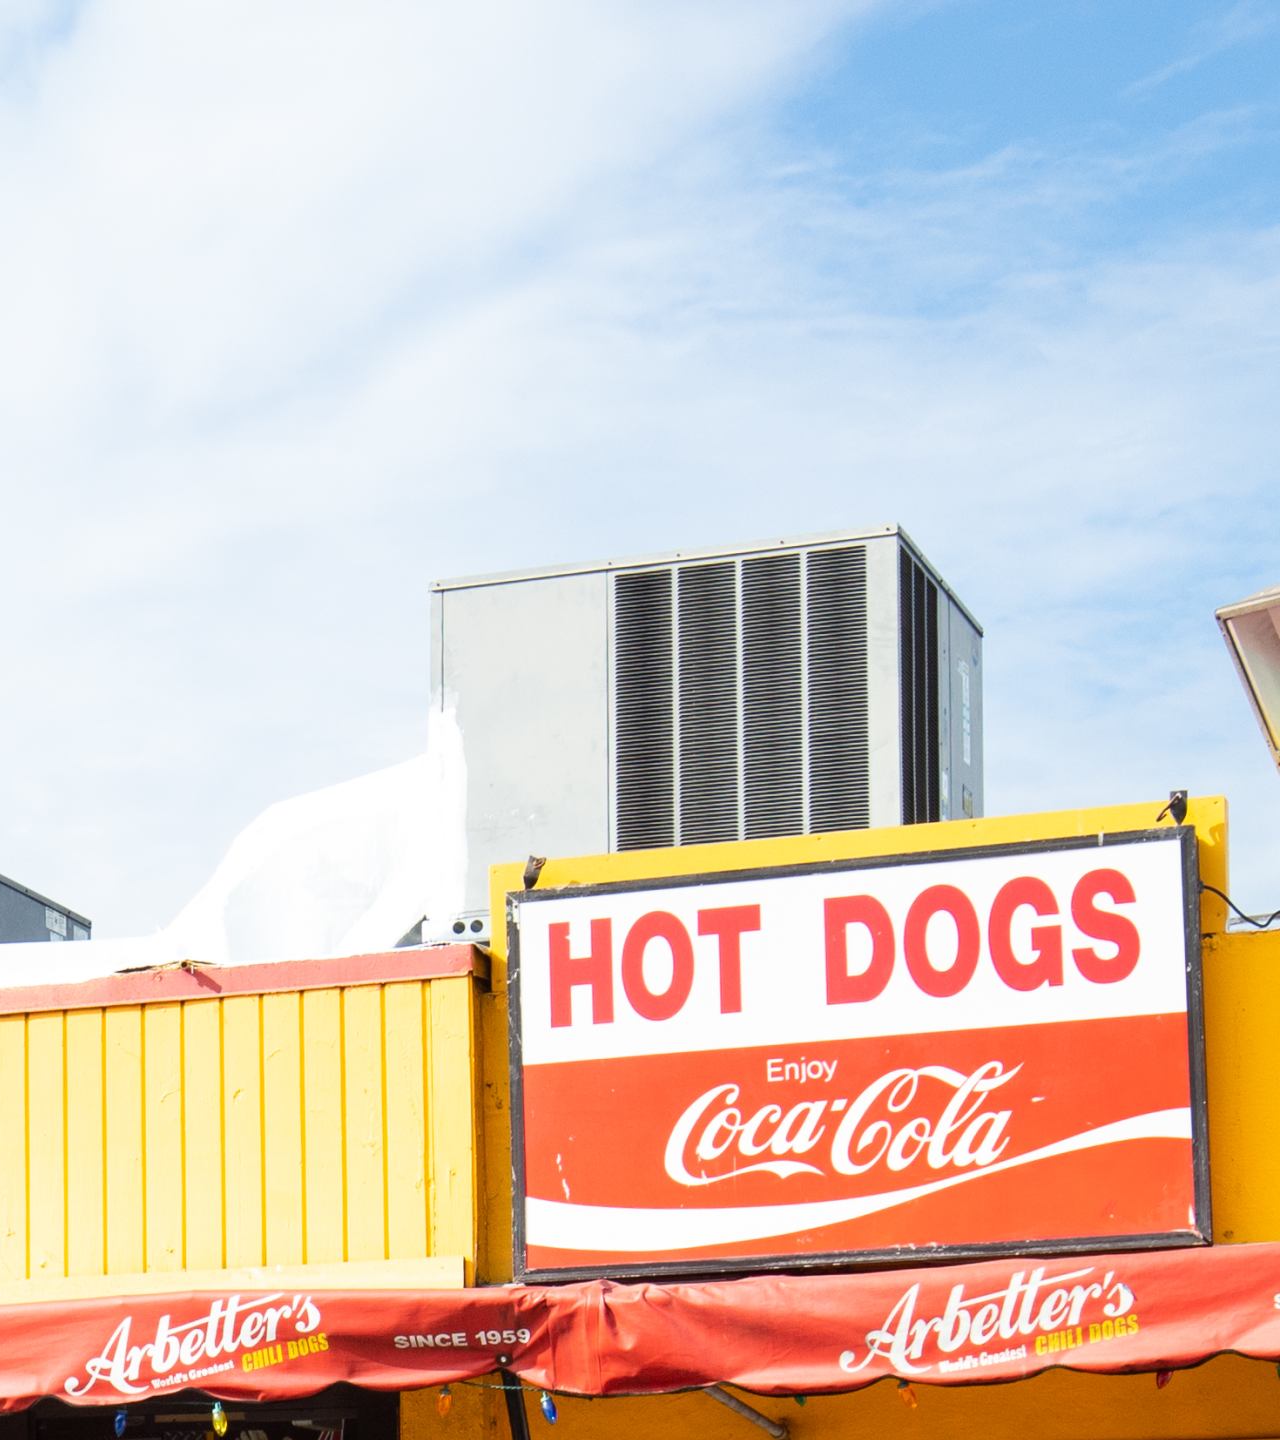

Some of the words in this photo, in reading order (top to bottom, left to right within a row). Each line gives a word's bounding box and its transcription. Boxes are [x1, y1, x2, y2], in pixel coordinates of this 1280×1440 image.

[547, 904, 762, 1029] HOT
[822, 867, 1141, 1007] DOGS
[765, 1055, 839, 1086] Enjoy
[664, 1060, 1026, 1188] Coca-Cola
[64, 1293, 321, 1396] Arbetter's
[394, 1332, 467, 1350] SINCE
[474, 1328, 531, 1346] 1959
[840, 1266, 1137, 1376] Arbetter's
[980, 1344, 1027, 1367] Greatest
[1035, 1329, 1085, 1357] CHILI
[1089, 1314, 1140, 1344] DOGS
[151, 1370, 189, 1390] World's
[189, 1360, 234, 1381] Greatest
[241, 1348, 285, 1373] CHILI
[287, 1333, 329, 1359] DOGS
